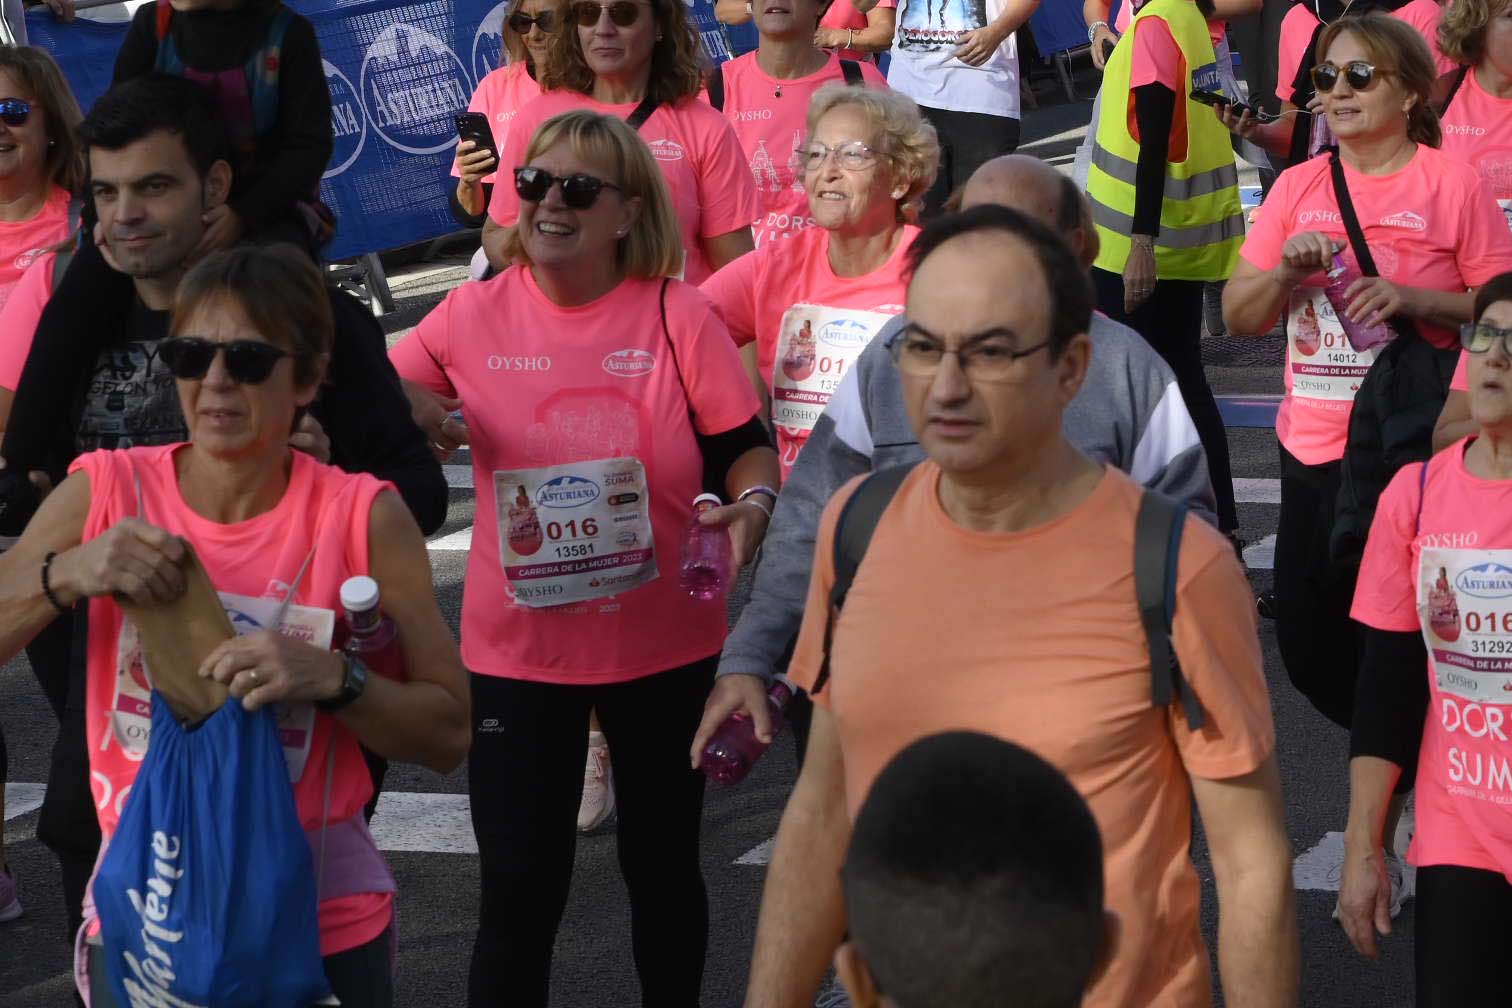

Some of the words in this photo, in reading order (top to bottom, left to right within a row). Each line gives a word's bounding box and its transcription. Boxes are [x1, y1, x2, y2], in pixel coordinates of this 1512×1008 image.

[371, 78, 469, 128] ASTURIANA
[766, 212, 816, 230] DORS
[1324, 333, 1347, 348] 01
[487, 355, 551, 371] OYSHO
[819, 357, 844, 374] 01
[1328, 353, 1357, 363] 14012
[1301, 366, 1329, 375] CARRERA
[821, 380, 838, 390] 135
[1301, 380, 1330, 391] OYSHO
[786, 391, 817, 401] CARRERA
[782, 407, 817, 421] OYSHO
[605, 476, 634, 486] SUMA
[540, 490, 596, 503] ASTURIANA
[547, 518, 598, 540] 016
[555, 543, 595, 559] 13581
[519, 566, 559, 577] CARRERA
[561, 564, 574, 572] DE
[575, 562, 587, 571] LA
[589, 557, 619, 568] MUJER
[1445, 654, 1475, 667] CARRERA
[1477, 659, 1490, 668] DE
[1491, 660, 1503, 669] LA
